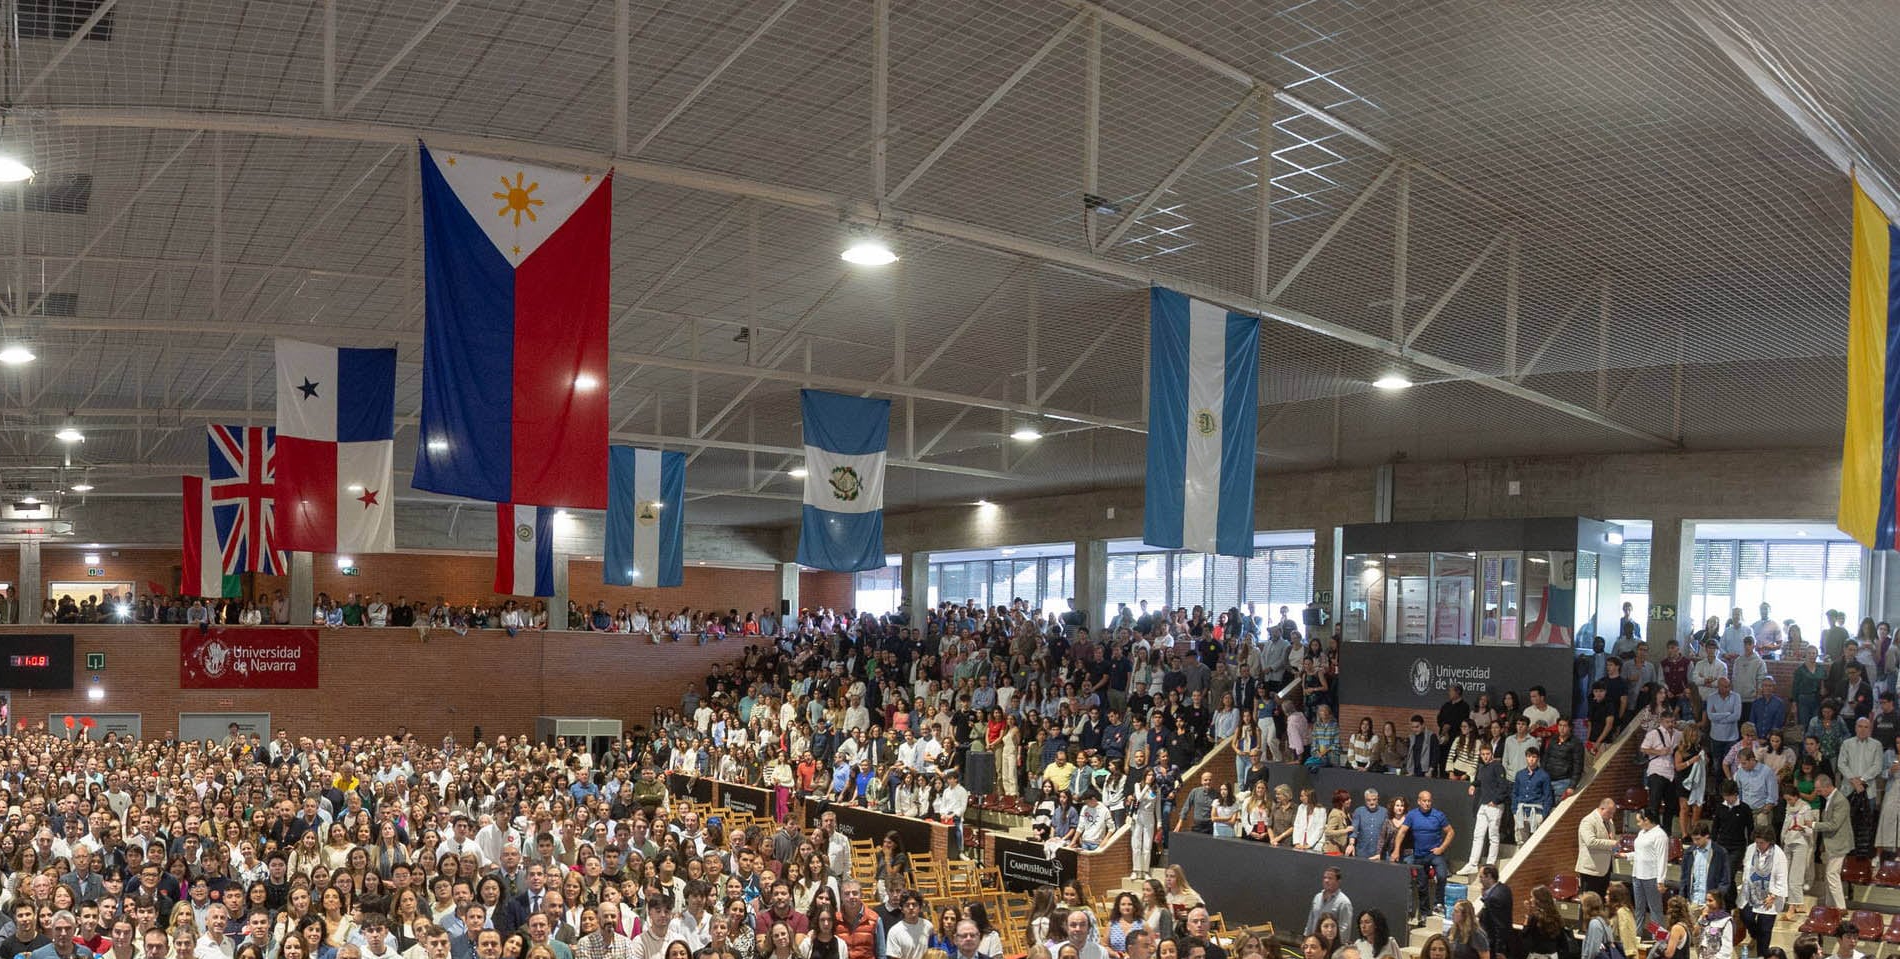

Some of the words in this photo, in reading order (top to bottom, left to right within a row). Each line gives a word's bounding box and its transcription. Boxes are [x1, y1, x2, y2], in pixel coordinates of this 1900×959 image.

[233, 645, 301, 659] Universidad
[233, 660, 247, 671] de
[250, 659, 296, 672] Navarra
[1436, 664, 1491, 679] Universidad
[1435, 678, 1447, 690] de
